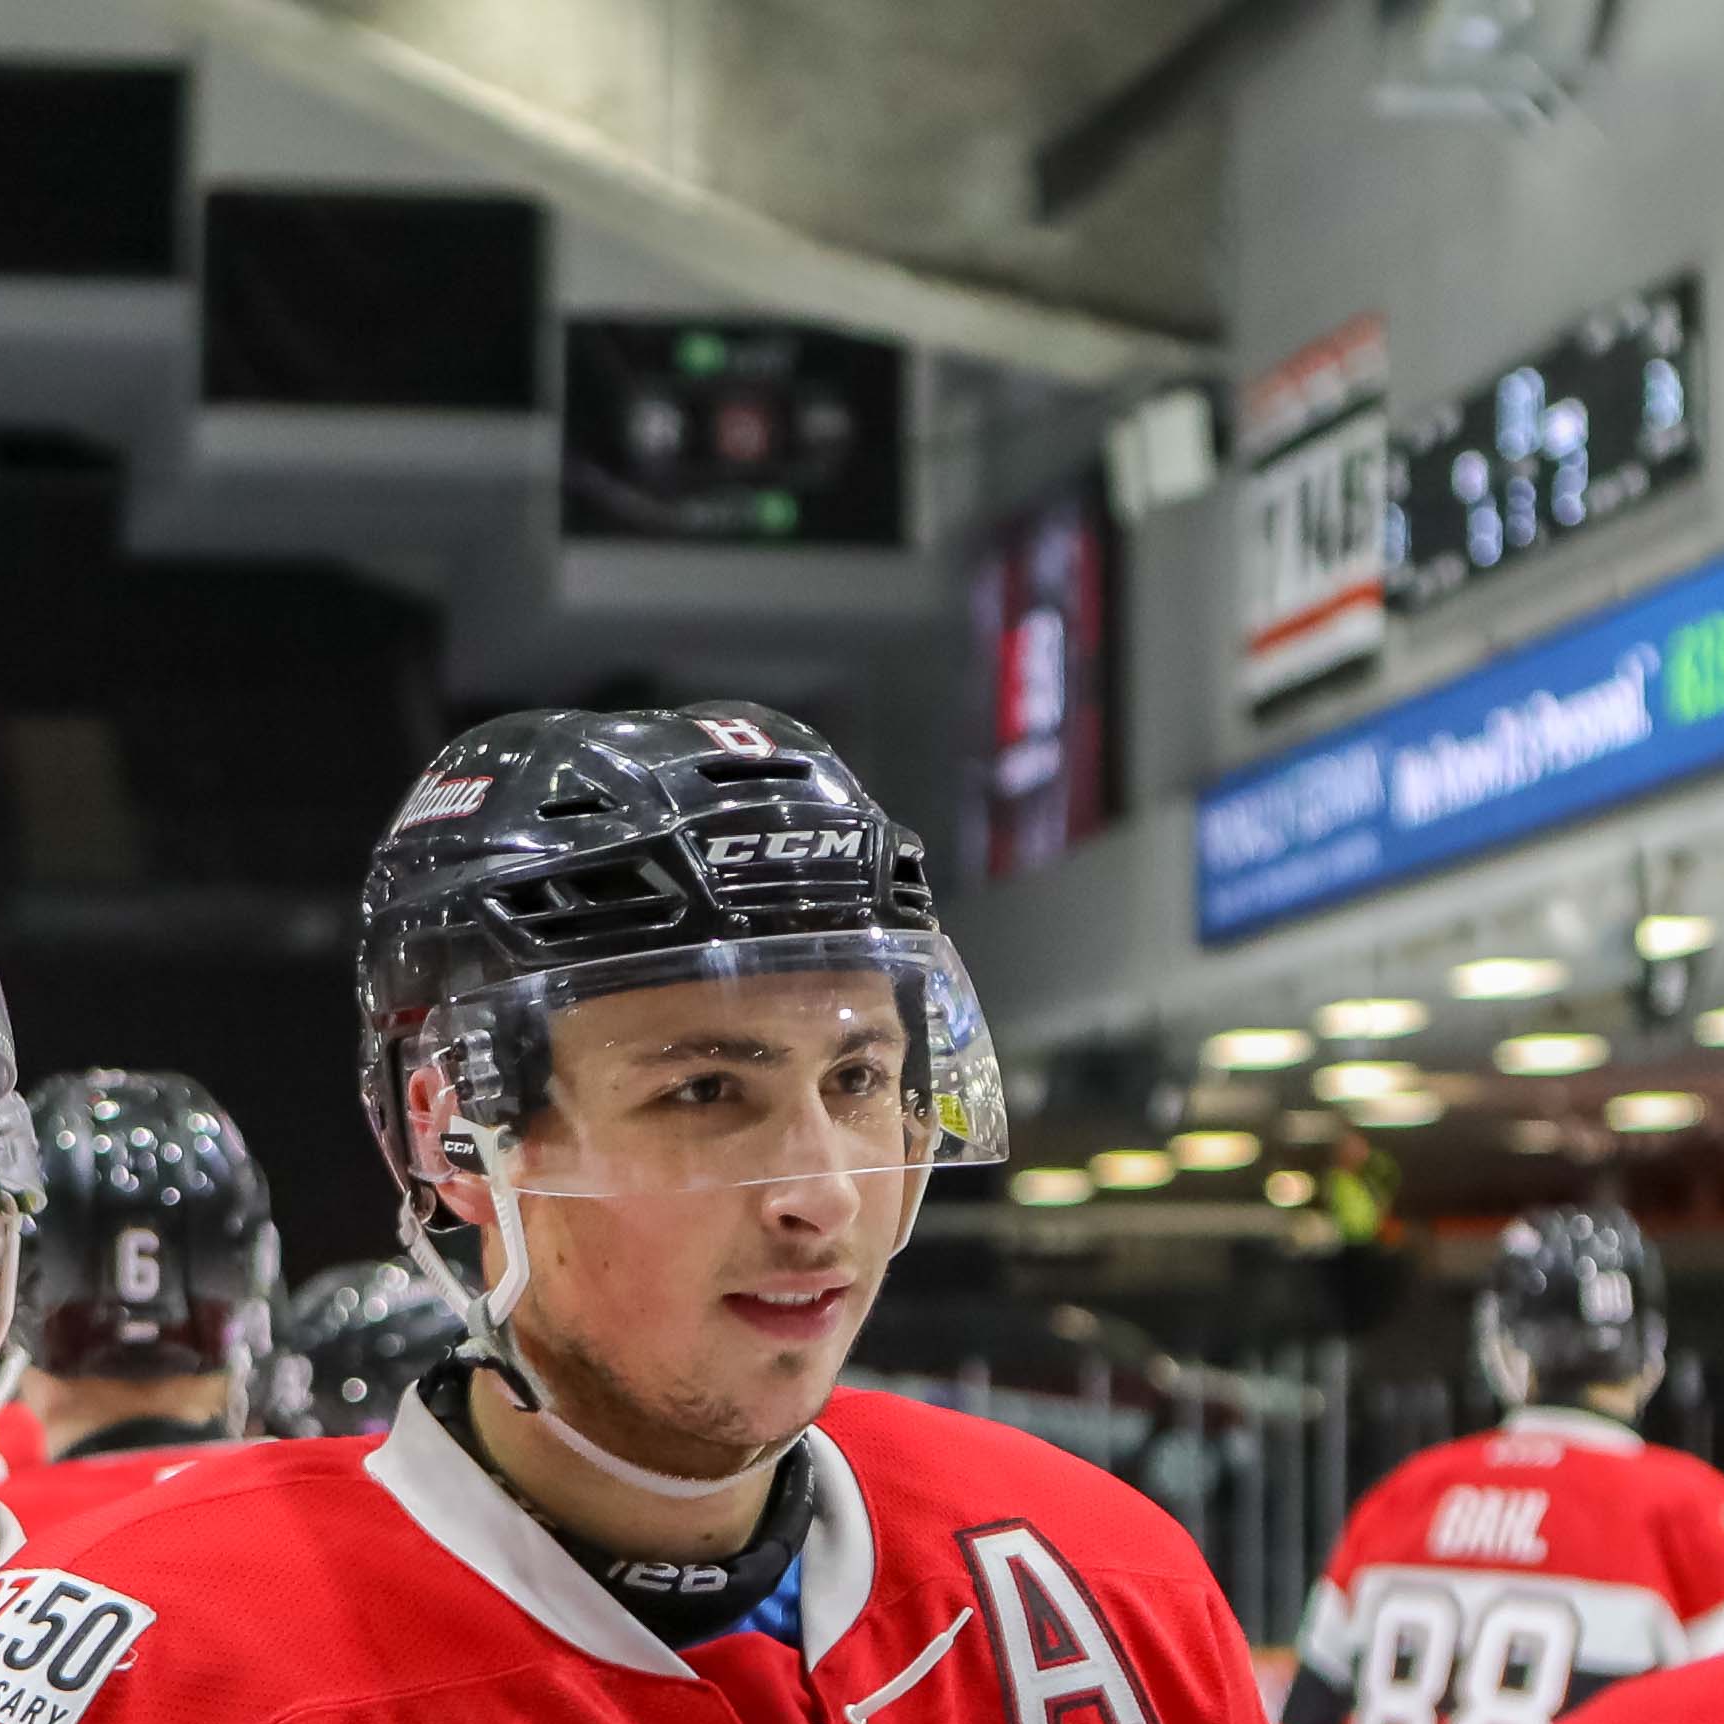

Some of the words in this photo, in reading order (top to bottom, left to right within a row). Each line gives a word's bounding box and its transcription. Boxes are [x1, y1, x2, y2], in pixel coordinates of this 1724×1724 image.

[694, 717, 776, 760] 8
[704, 831, 869, 867] CCM
[442, 1138, 477, 1156] CCM
[115, 1227, 161, 1302] 6
